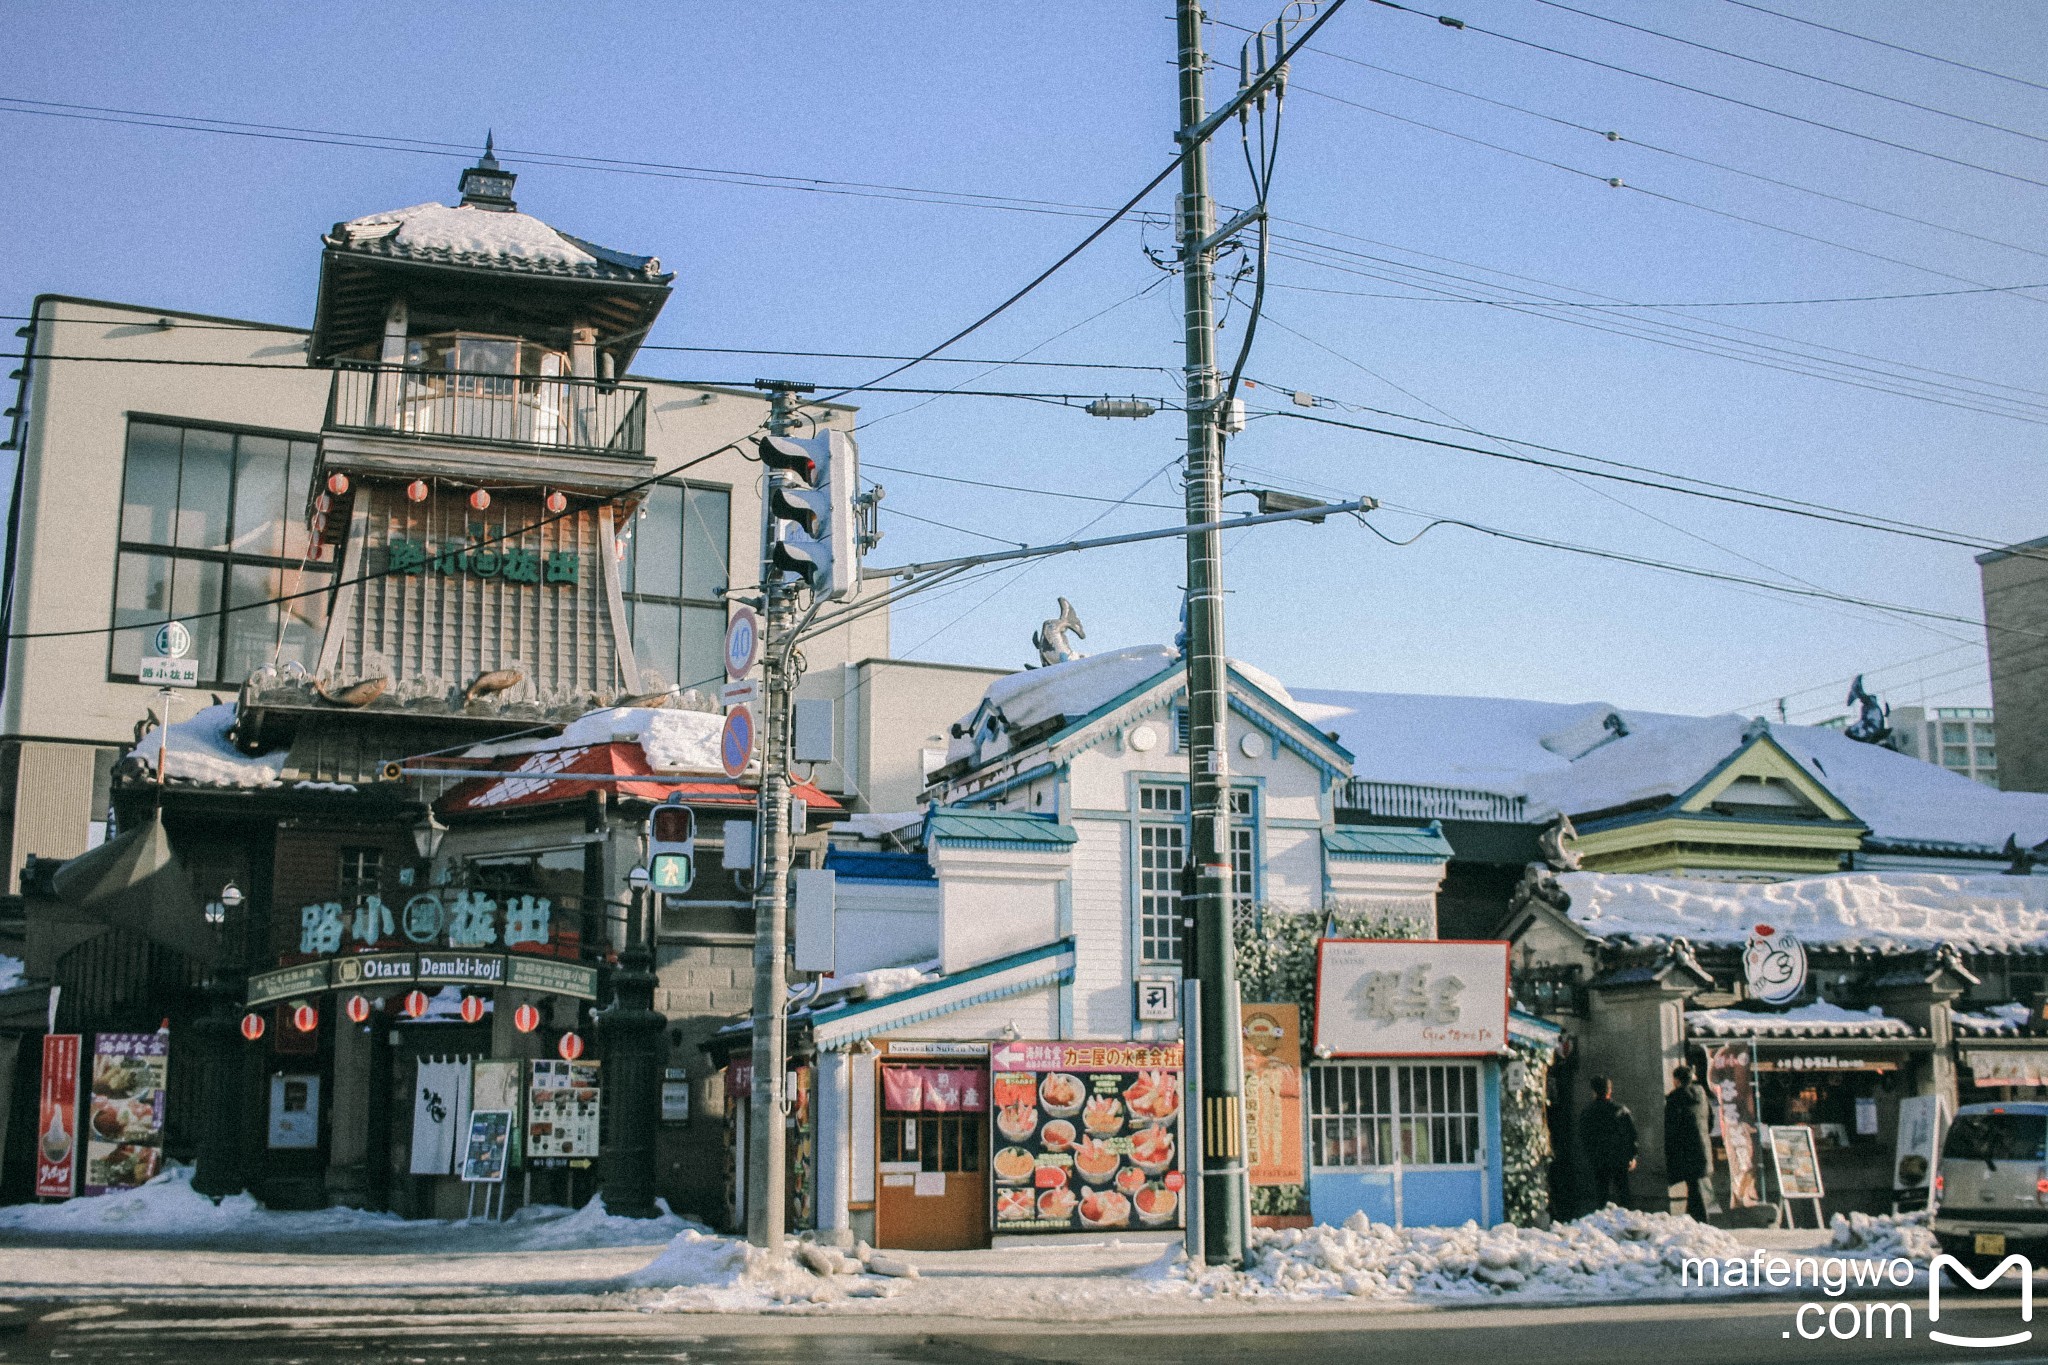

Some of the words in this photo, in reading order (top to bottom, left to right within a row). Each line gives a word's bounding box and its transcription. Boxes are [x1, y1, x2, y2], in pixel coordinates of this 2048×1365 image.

[731, 627, 750, 659] 40
[363, 960, 412, 978] Otaru
[421, 958, 501, 979] Denuki-koji
[891, 1043, 934, 1053] Sawasaki
[937, 1043, 966, 1053] Suisan
